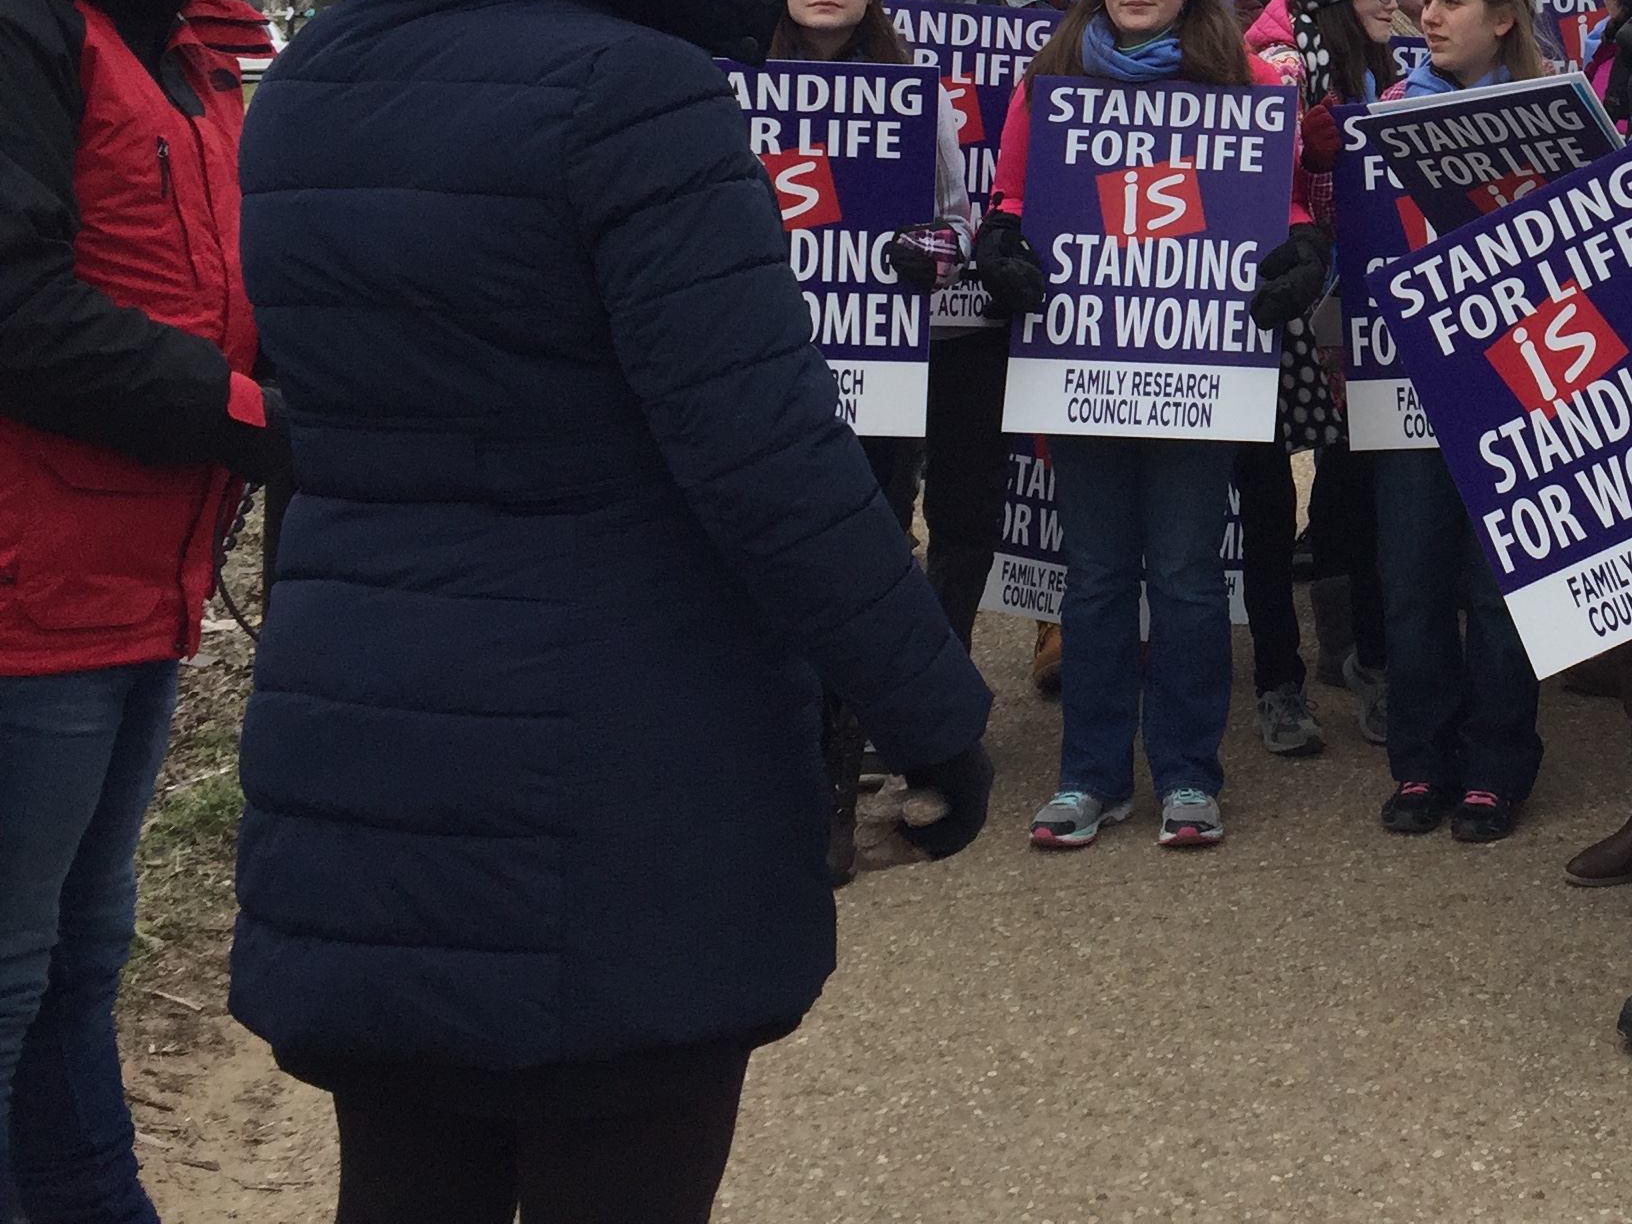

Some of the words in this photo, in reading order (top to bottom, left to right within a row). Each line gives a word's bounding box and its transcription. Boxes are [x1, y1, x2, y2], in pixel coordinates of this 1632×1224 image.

[882, 8, 1052, 52] ANDING
[1578, 15, 1588, 60] i
[952, 51, 1033, 87] LIFE
[727, 72, 923, 116] ANDING
[1048, 86, 1285, 132] STANDING
[799, 118, 901, 159] LIFE
[1065, 128, 1155, 168] FOR
[1169, 133, 1264, 173] LIFE
[1380, 99, 1585, 158] STANDING
[1417, 152, 1503, 189] FOR
[1499, 137, 1592, 177] LIFE
[775, 161, 820, 221] s
[790, 229, 898, 284] DING
[1049, 233, 1258, 292] STANDING
[802, 291, 920, 347] OMEN
[1022, 293, 1103, 346] FOR
[1115, 295, 1274, 353] WOMEN
[1428, 277, 1537, 356] FOR
[1351, 316, 1397, 366] FO
[1064, 368, 1127, 396] FAMILY
[1131, 371, 1220, 400] RESEARCH
[1067, 397, 1142, 425] COUNCIL
[1147, 401, 1213, 428] ACTION
[1482, 483, 1588, 575] FOR
[1001, 560, 1047, 591] FAMILY
[1002, 584, 1054, 615] COUNCIL
